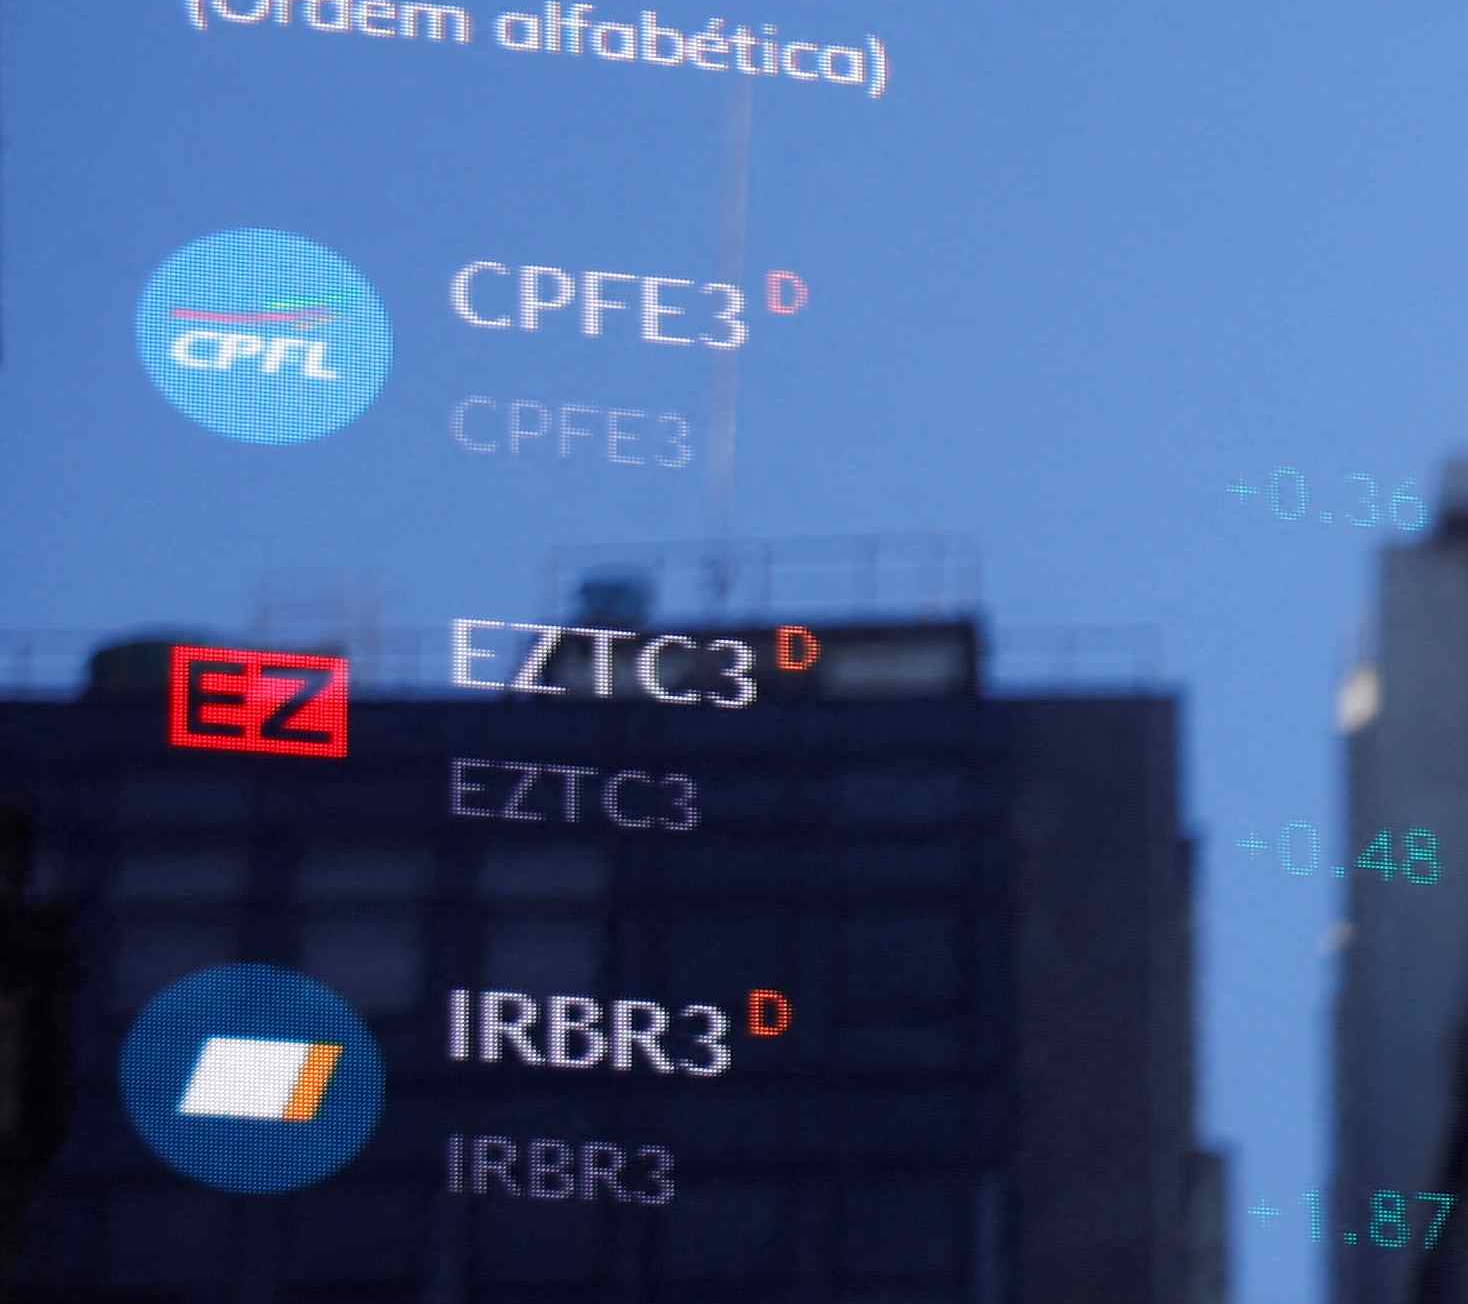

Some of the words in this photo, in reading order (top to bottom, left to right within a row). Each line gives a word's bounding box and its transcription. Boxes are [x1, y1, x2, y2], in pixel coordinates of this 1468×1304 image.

[494, 0, 892, 100] alfabética)
[449, 259, 750, 352] CPFE3
[763, 270, 810, 317] D
[168, 328, 340, 383] CPFL
[451, 395, 694, 470] CPFE3
[1225, 465, 1430, 534] +0.36
[450, 617, 760, 709] EZTC3
[775, 623, 822, 673] D
[186, 660, 332, 744] EZ
[451, 756, 701, 833] EZTC3
[1235, 820, 1444, 887] +0.48
[447, 987, 735, 1078] IRBR3
[747, 988, 794, 1039] D
[447, 1132, 676, 1207] IRBR3
[1247, 1187, 1460, 1250] +1.87
